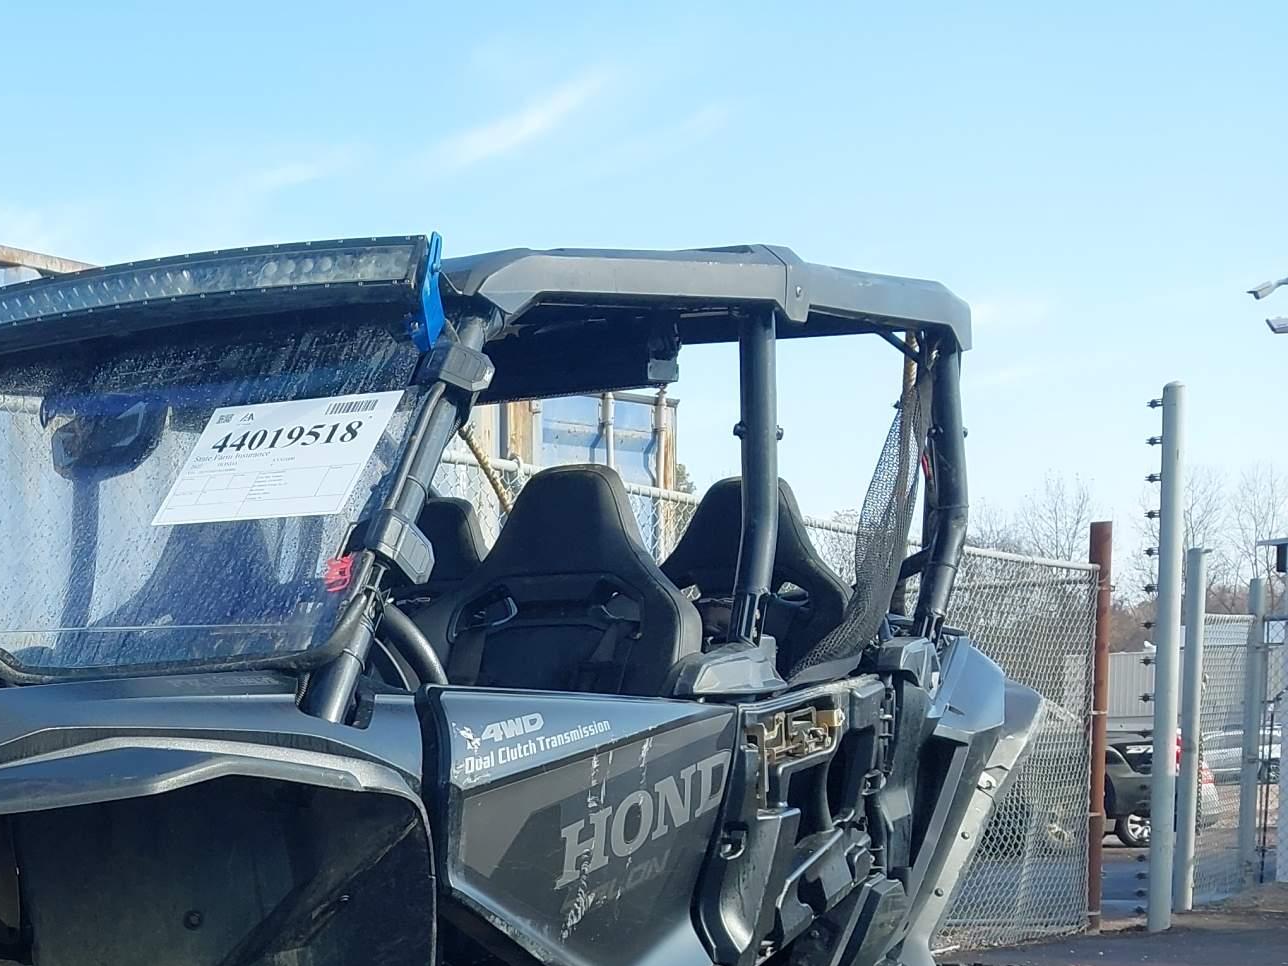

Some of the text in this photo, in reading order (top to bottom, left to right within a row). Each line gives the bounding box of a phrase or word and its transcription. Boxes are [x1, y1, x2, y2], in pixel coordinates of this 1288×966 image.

[211, 420, 364, 453] 44019518
[481, 712, 544, 742] 4WD
[464, 719, 611, 774] Dual Clutch Transmission
